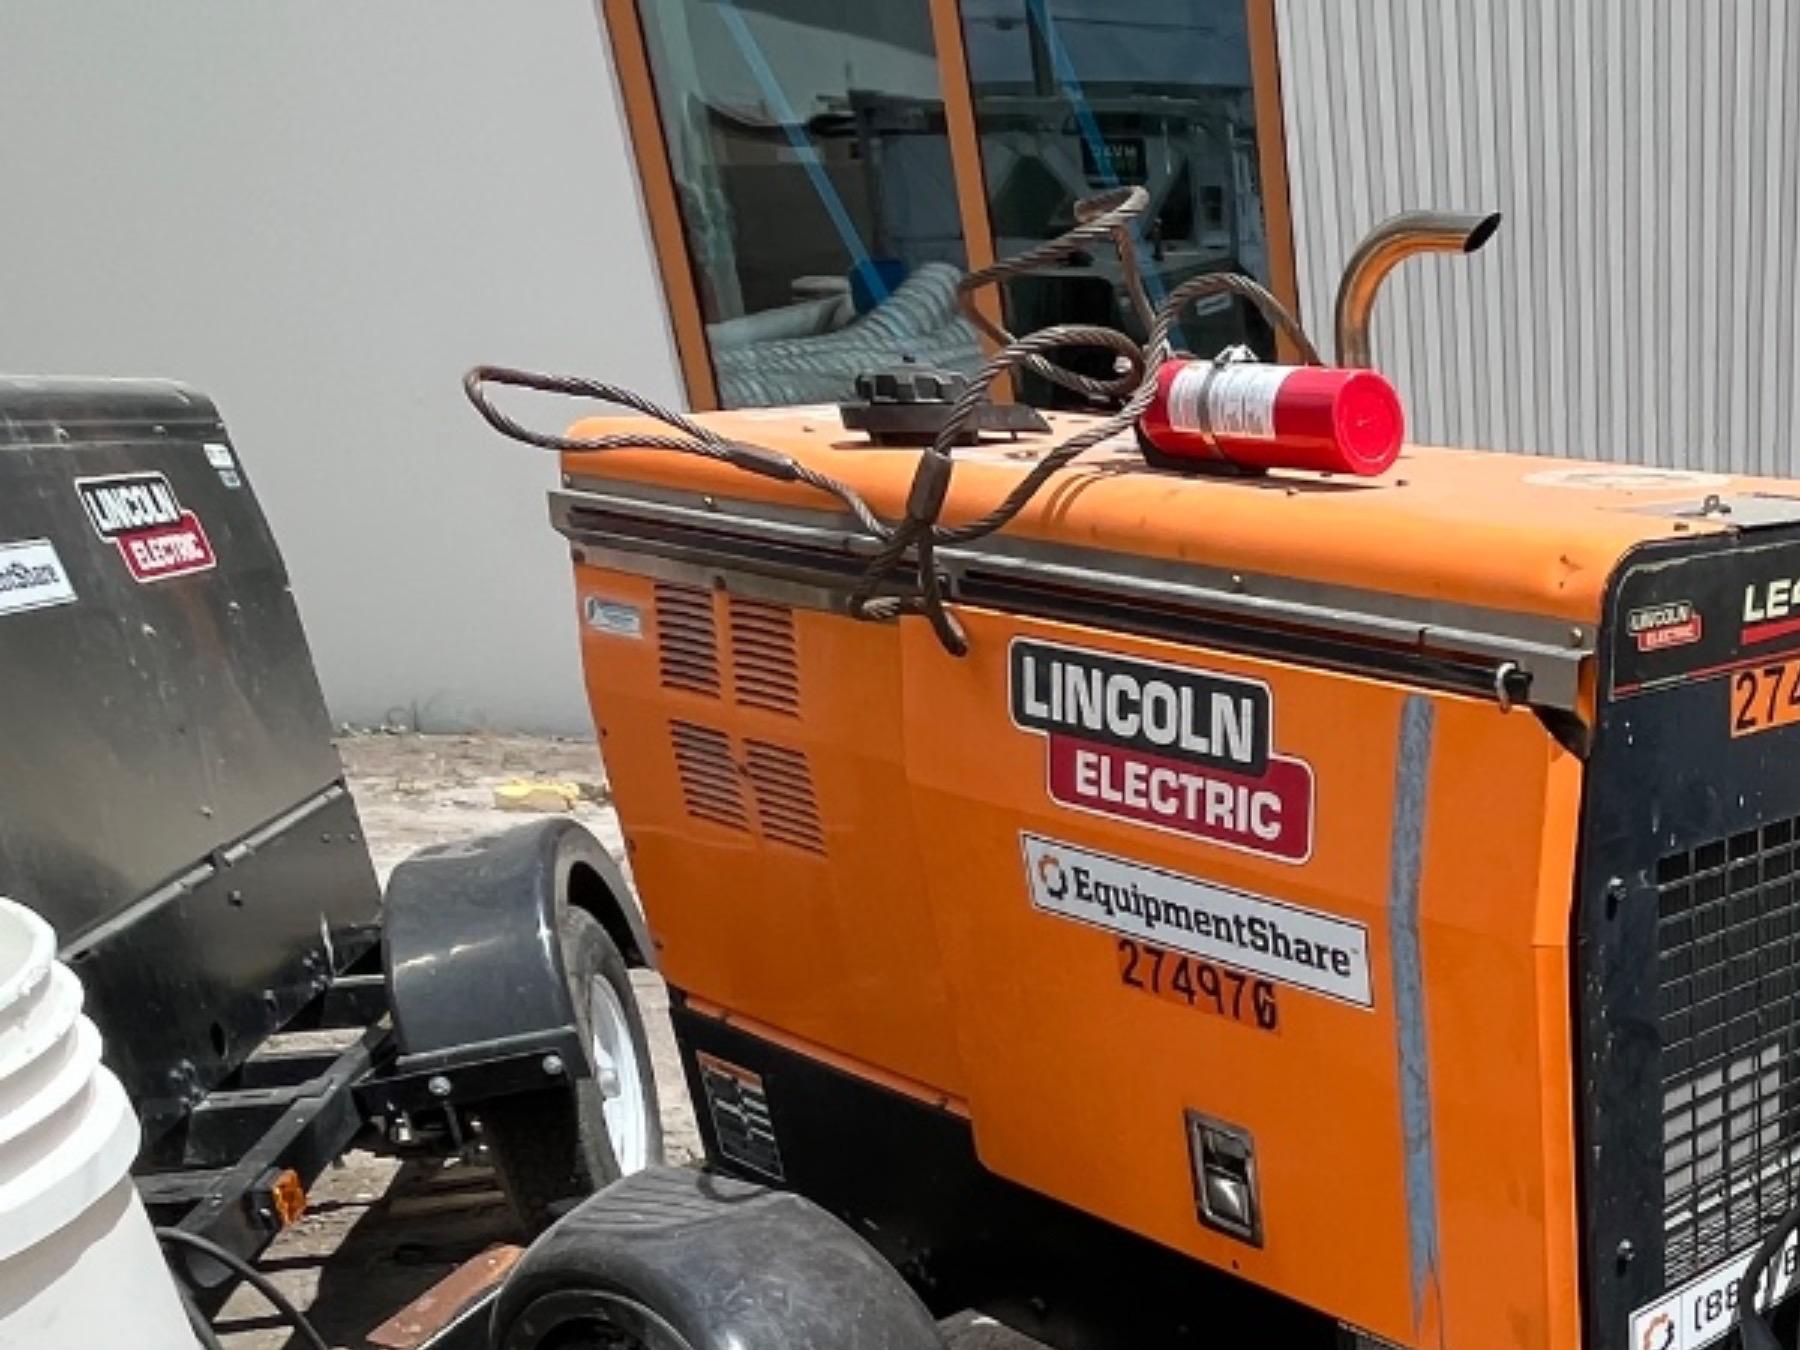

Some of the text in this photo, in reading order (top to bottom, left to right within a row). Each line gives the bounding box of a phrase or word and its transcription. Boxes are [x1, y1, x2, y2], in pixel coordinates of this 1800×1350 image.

[83, 483, 180, 531] LINCOLN
[129, 532, 206, 570] ELECTRIC
[1022, 655, 1254, 763] LINCOLN
[1075, 749, 1282, 841] ELECTRIC
[1072, 865, 1352, 977] EquipmentShare
